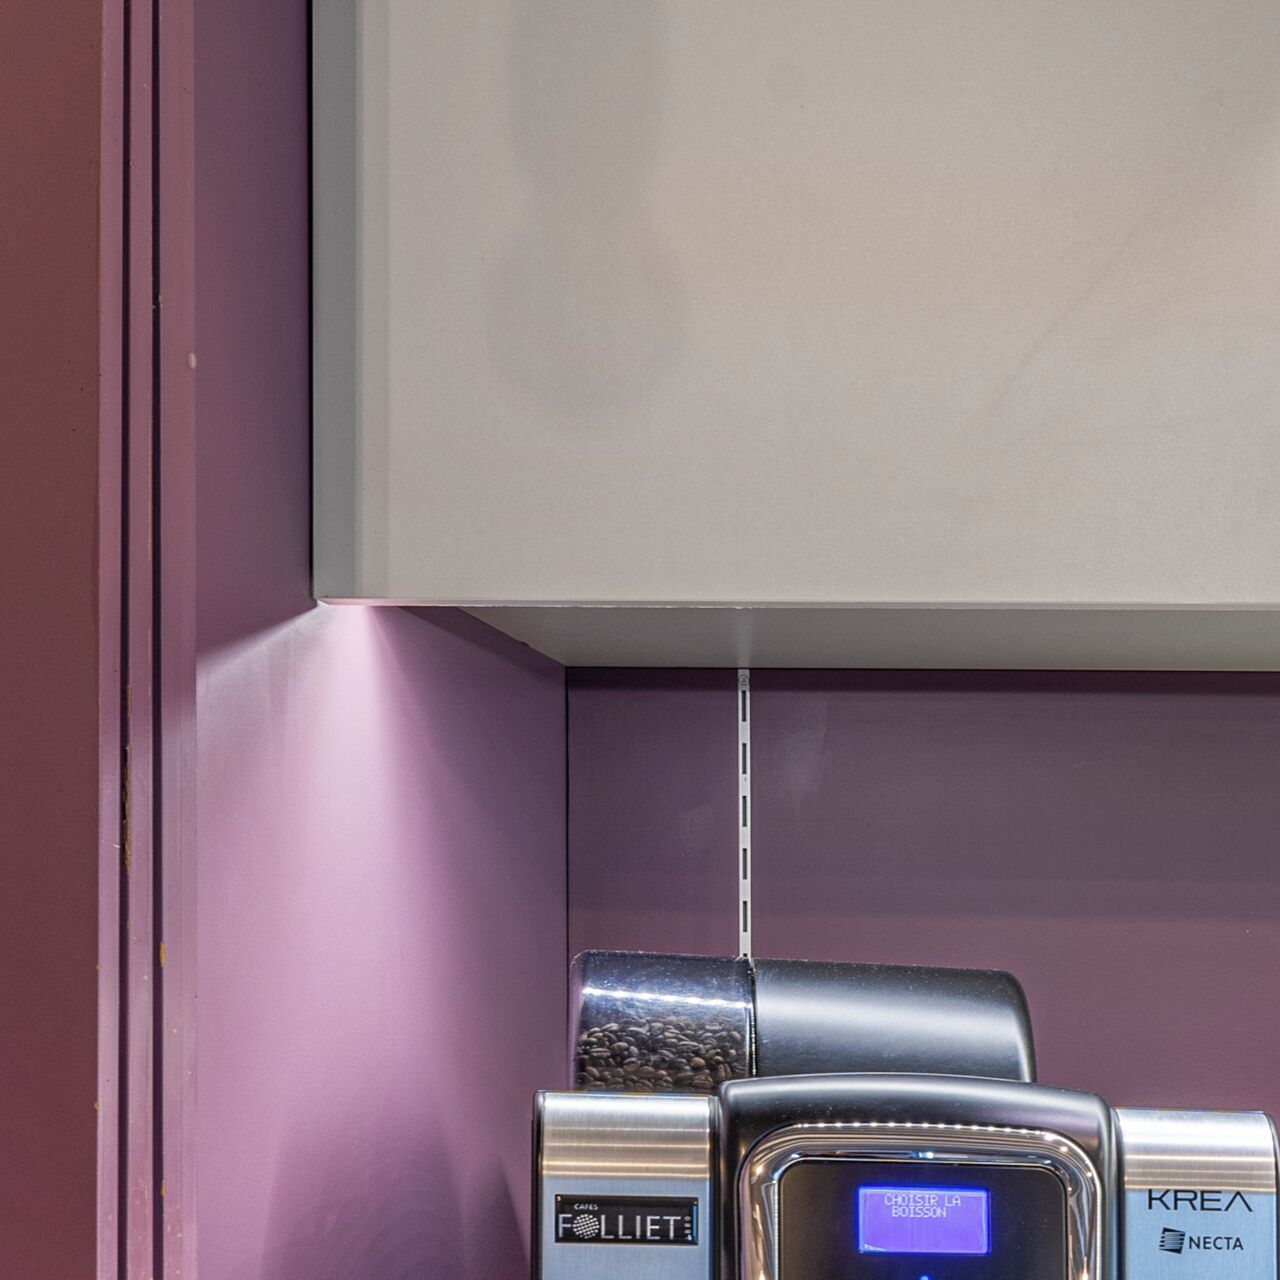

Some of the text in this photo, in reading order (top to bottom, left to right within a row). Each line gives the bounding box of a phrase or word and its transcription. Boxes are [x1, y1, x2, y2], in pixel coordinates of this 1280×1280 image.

[884, 1193, 961, 1207] CHOISIR LA
[1148, 1188, 1253, 1212] KREA
[892, 1206, 947, 1218] BOISSON
[558, 1213, 682, 1240] FOLLIET
[1188, 1236, 1244, 1250] NECTA
